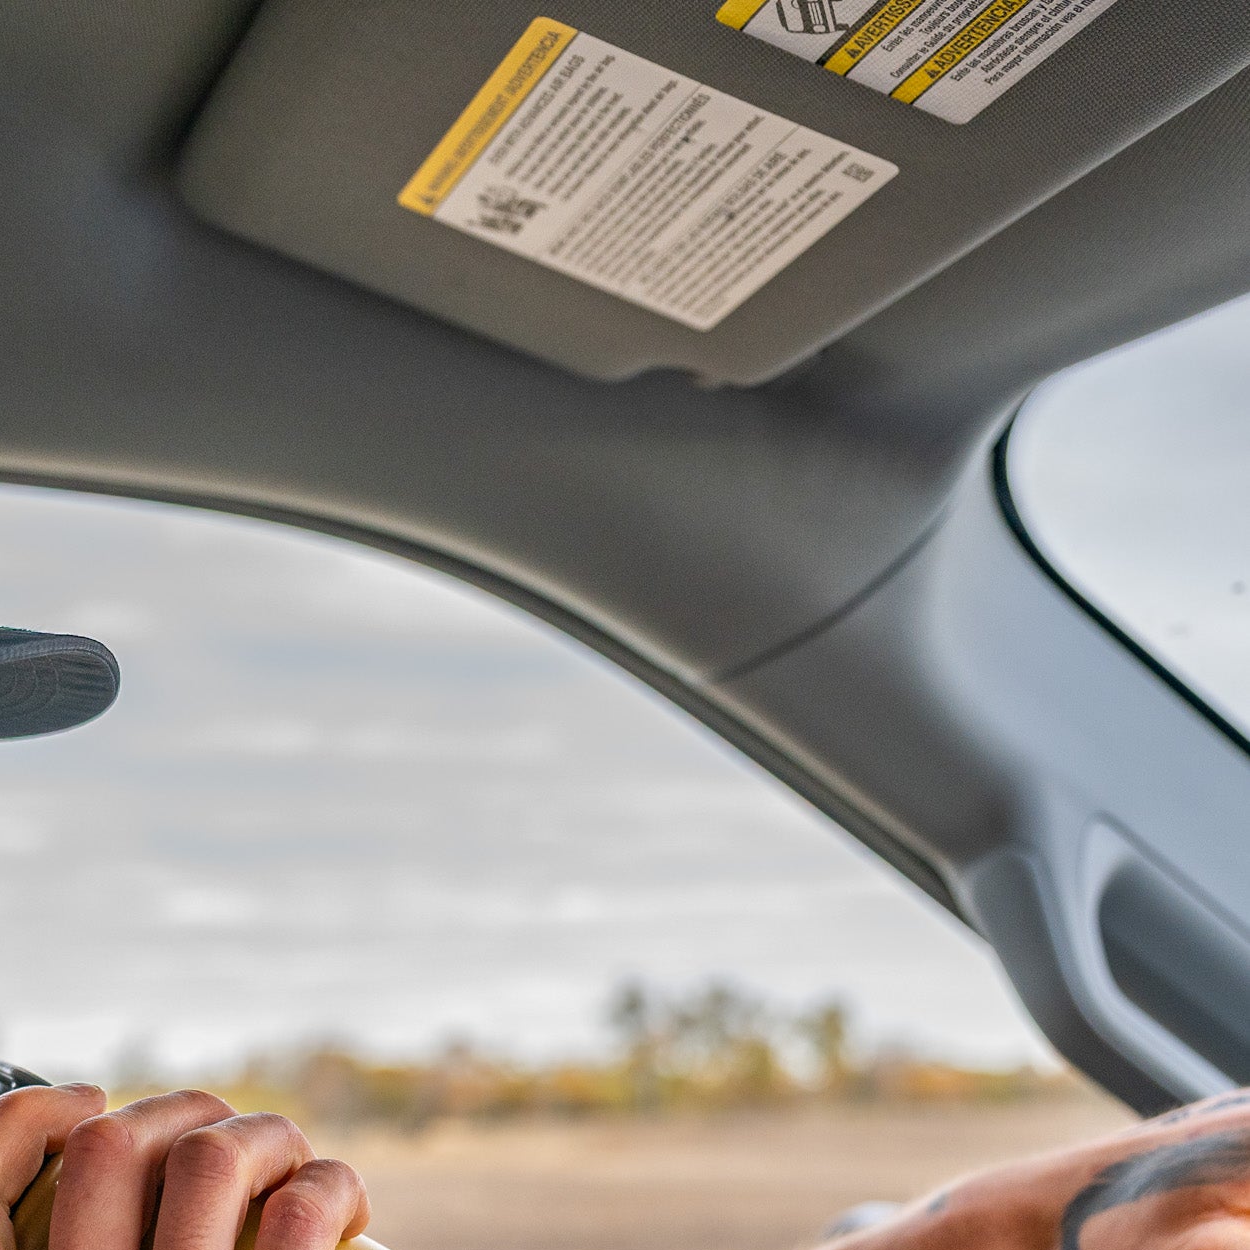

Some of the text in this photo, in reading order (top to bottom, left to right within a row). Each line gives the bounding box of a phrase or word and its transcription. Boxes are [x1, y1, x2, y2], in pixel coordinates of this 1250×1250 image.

[854, 0, 917, 50] AVERTISS
[911, 0, 947, 26] manoeuvr
[919, 10, 950, 35] Toujours
[1014, 22, 1044, 46] siempre
[1041, 15, 1052, 23] el
[890, 53, 922, 78] Consulter
[923, 30, 947, 47] Guide
[943, 23, 956, 33] du
[950, 66, 970, 82] Evite
[967, 57, 981, 70] las
[978, 32, 1013, 61] maniobras
[1009, 8, 1041, 33] bruscas
[1036, 3, 1047, 11] y
[984, 70, 1004, 86] Para
[1001, 55, 1025, 74] mayor
[1022, 23, 1063, 57] información
[1060, 12, 1077, 23] vea
[1073, 5, 1084, 13] el
